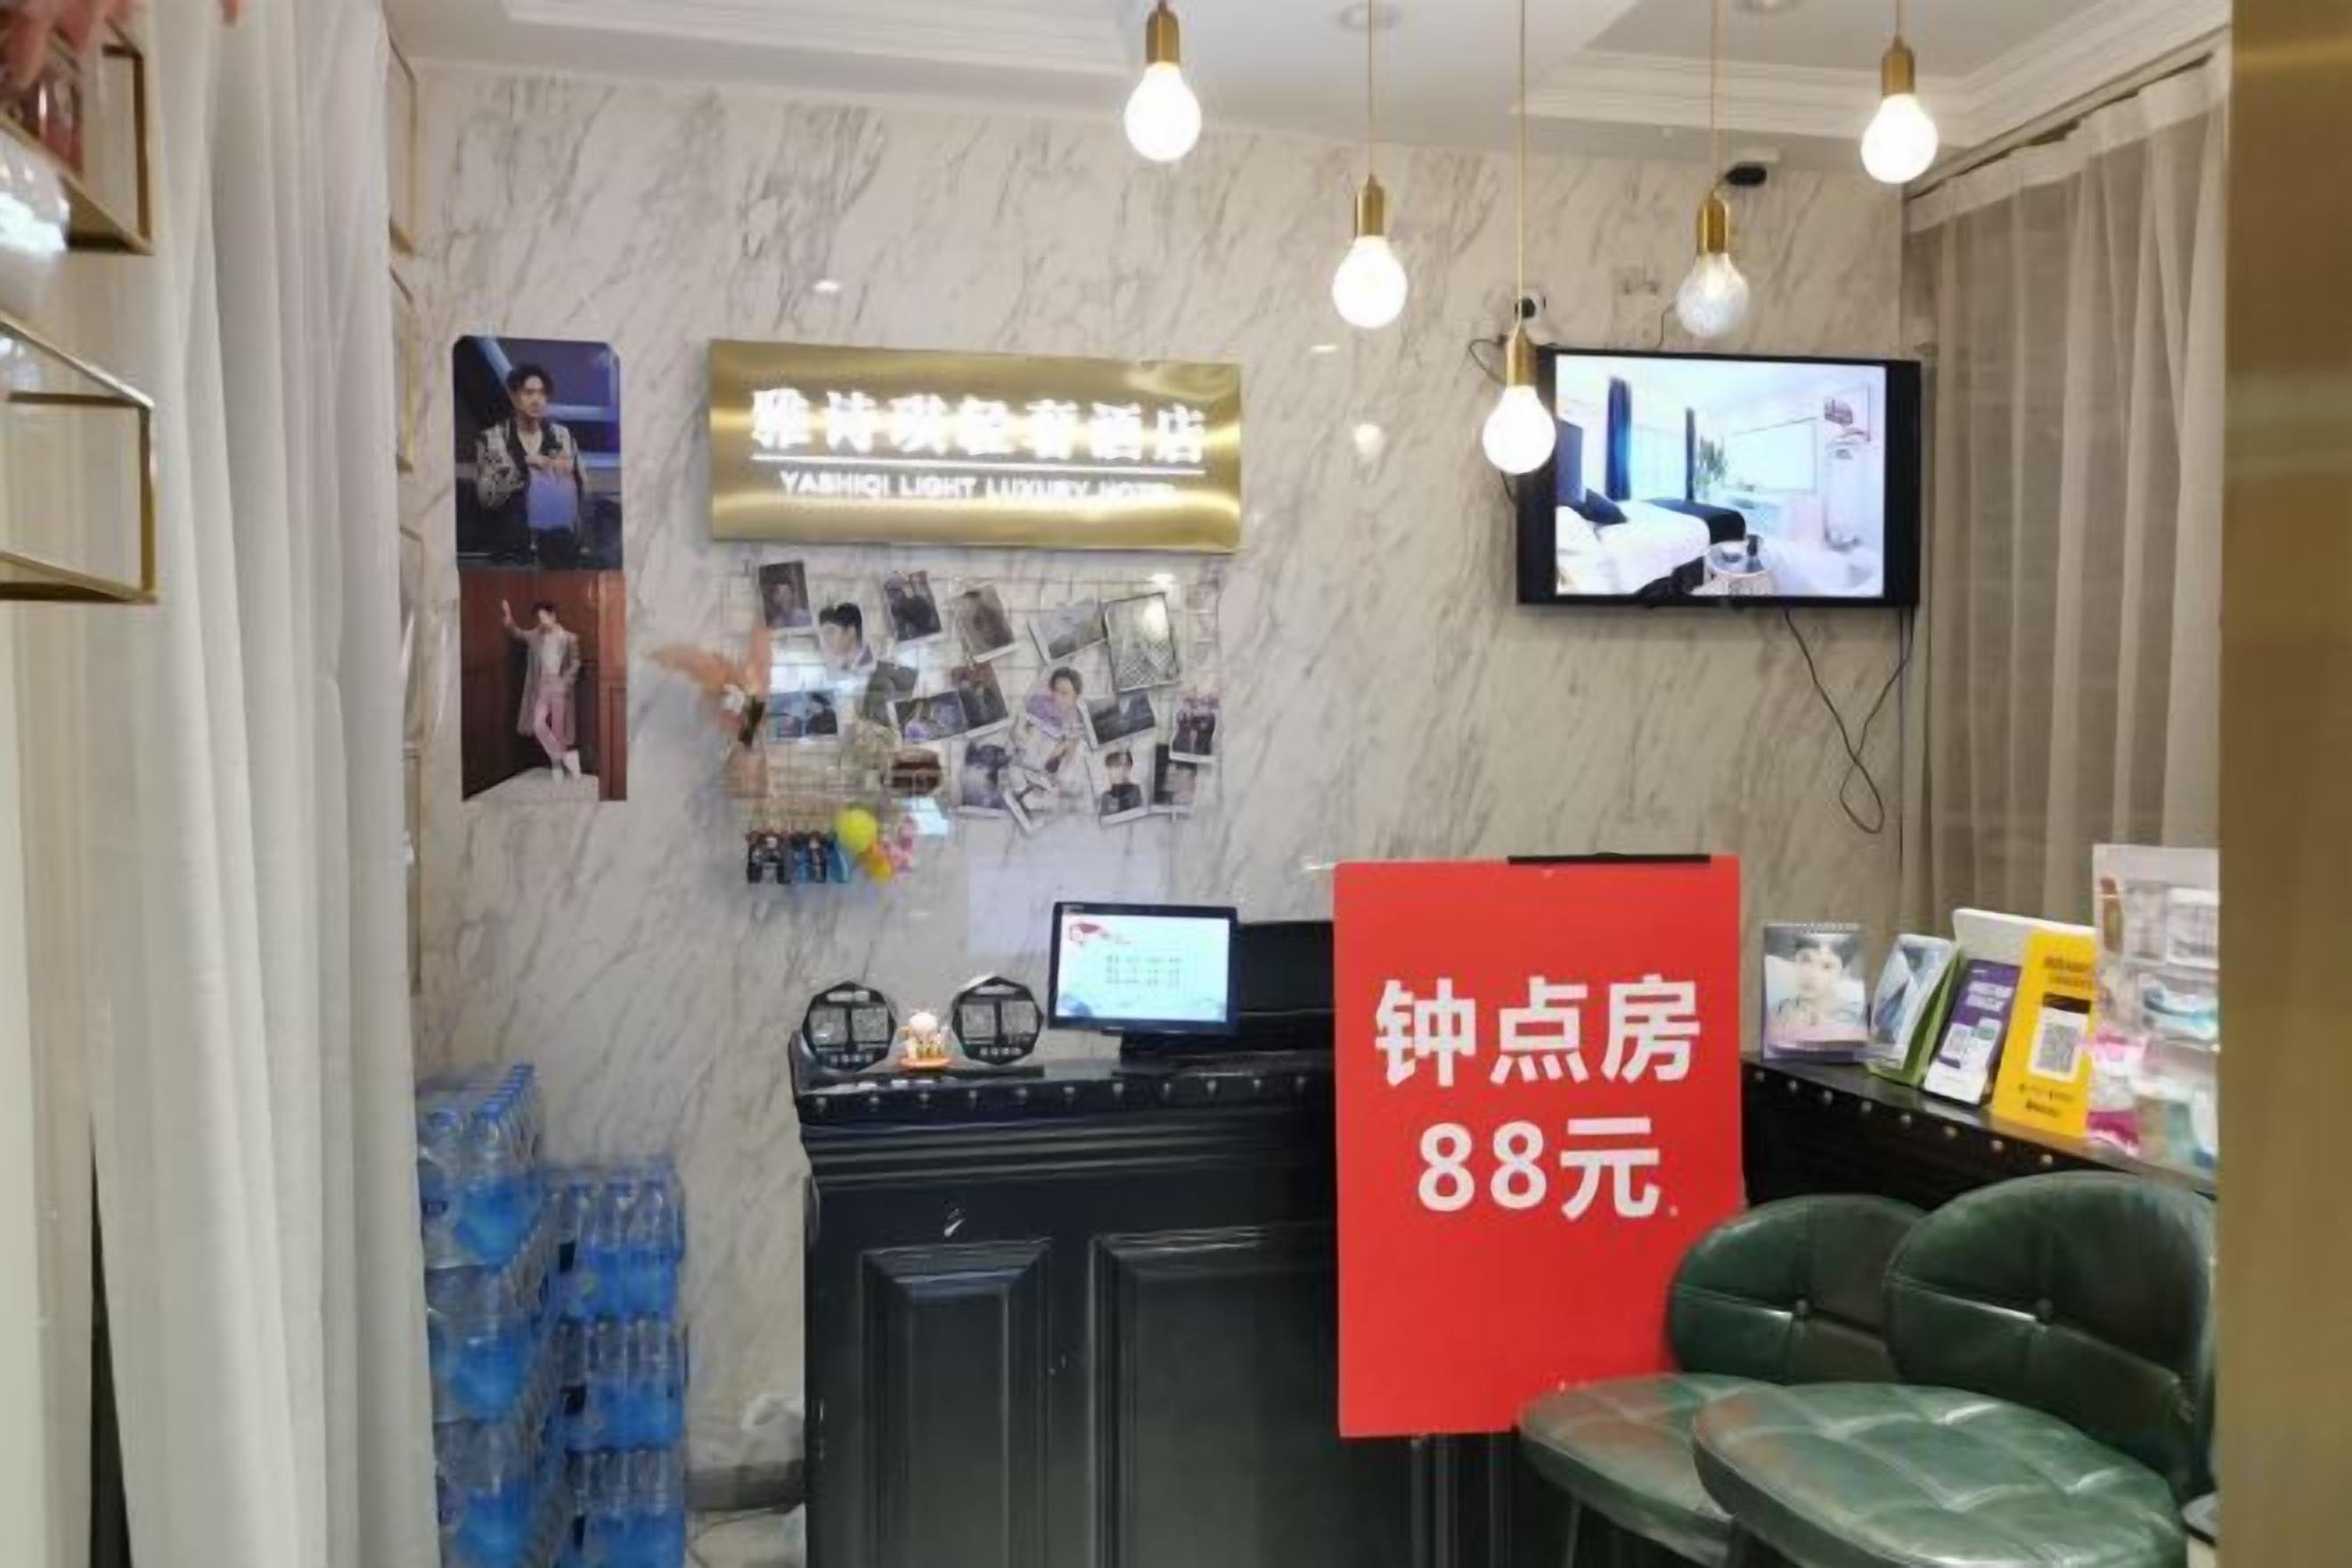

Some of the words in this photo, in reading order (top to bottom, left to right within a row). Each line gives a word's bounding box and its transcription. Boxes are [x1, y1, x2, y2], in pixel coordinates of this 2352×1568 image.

[780, 470, 891, 498] YASHIQI
[899, 473, 977, 500] LIGHT
[1098, 480, 1176, 506] HOT
[1375, 974, 1699, 1086] 钟点房
[1418, 1117, 1659, 1219] 88元
